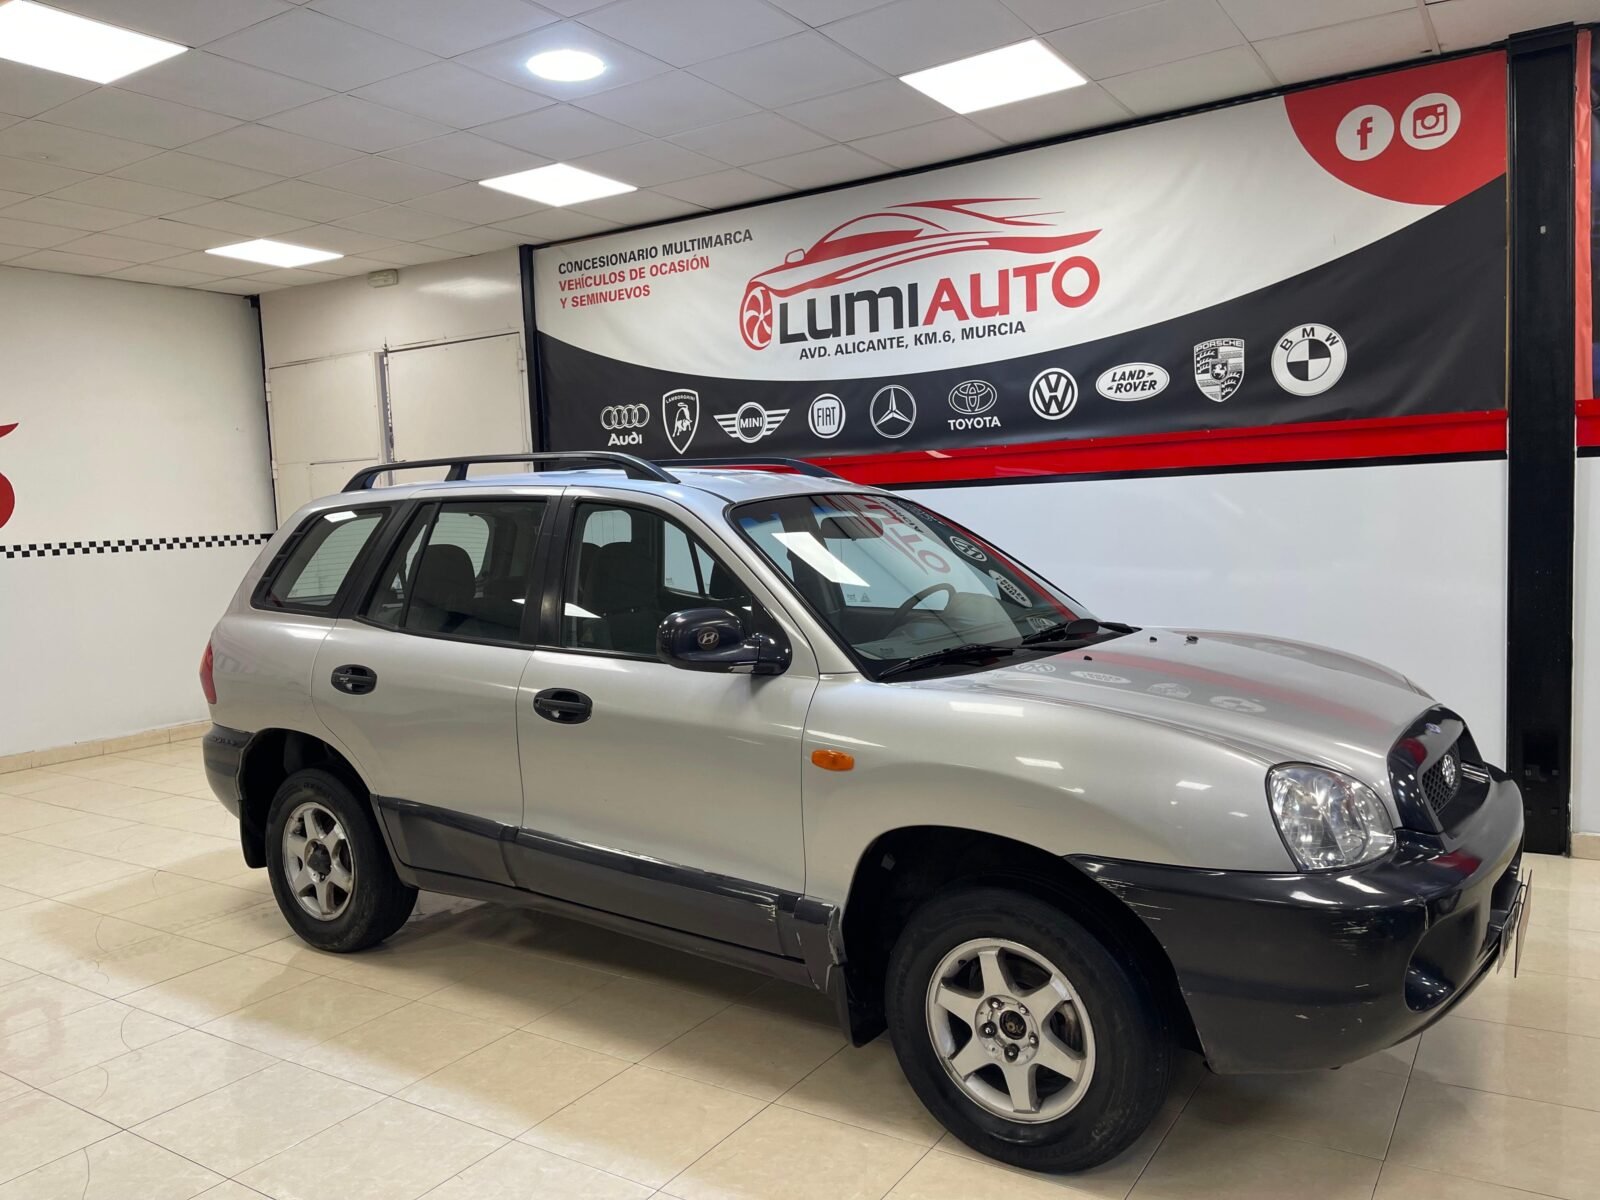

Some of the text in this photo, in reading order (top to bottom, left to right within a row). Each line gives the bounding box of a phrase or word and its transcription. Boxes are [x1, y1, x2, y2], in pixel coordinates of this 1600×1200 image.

[558, 229, 753, 275] CONCESIONARIO MULTIMARCA
[559, 254, 710, 292] VEHÍCULOS DE OCASIÓN
[560, 284, 650, 309] Y SEMINUEVOS
[799, 320, 1026, 361] AVD. ALICANTE, KM.6, MURCIA
[1196, 340, 1243, 352] PORSCHE
[1279, 327, 1340, 351] BMW
[739, 416, 763, 428] MINI
[816, 406, 837, 427] FIAT
[948, 415, 1001, 431] TOYOTA
[608, 431, 642, 446] Audi
